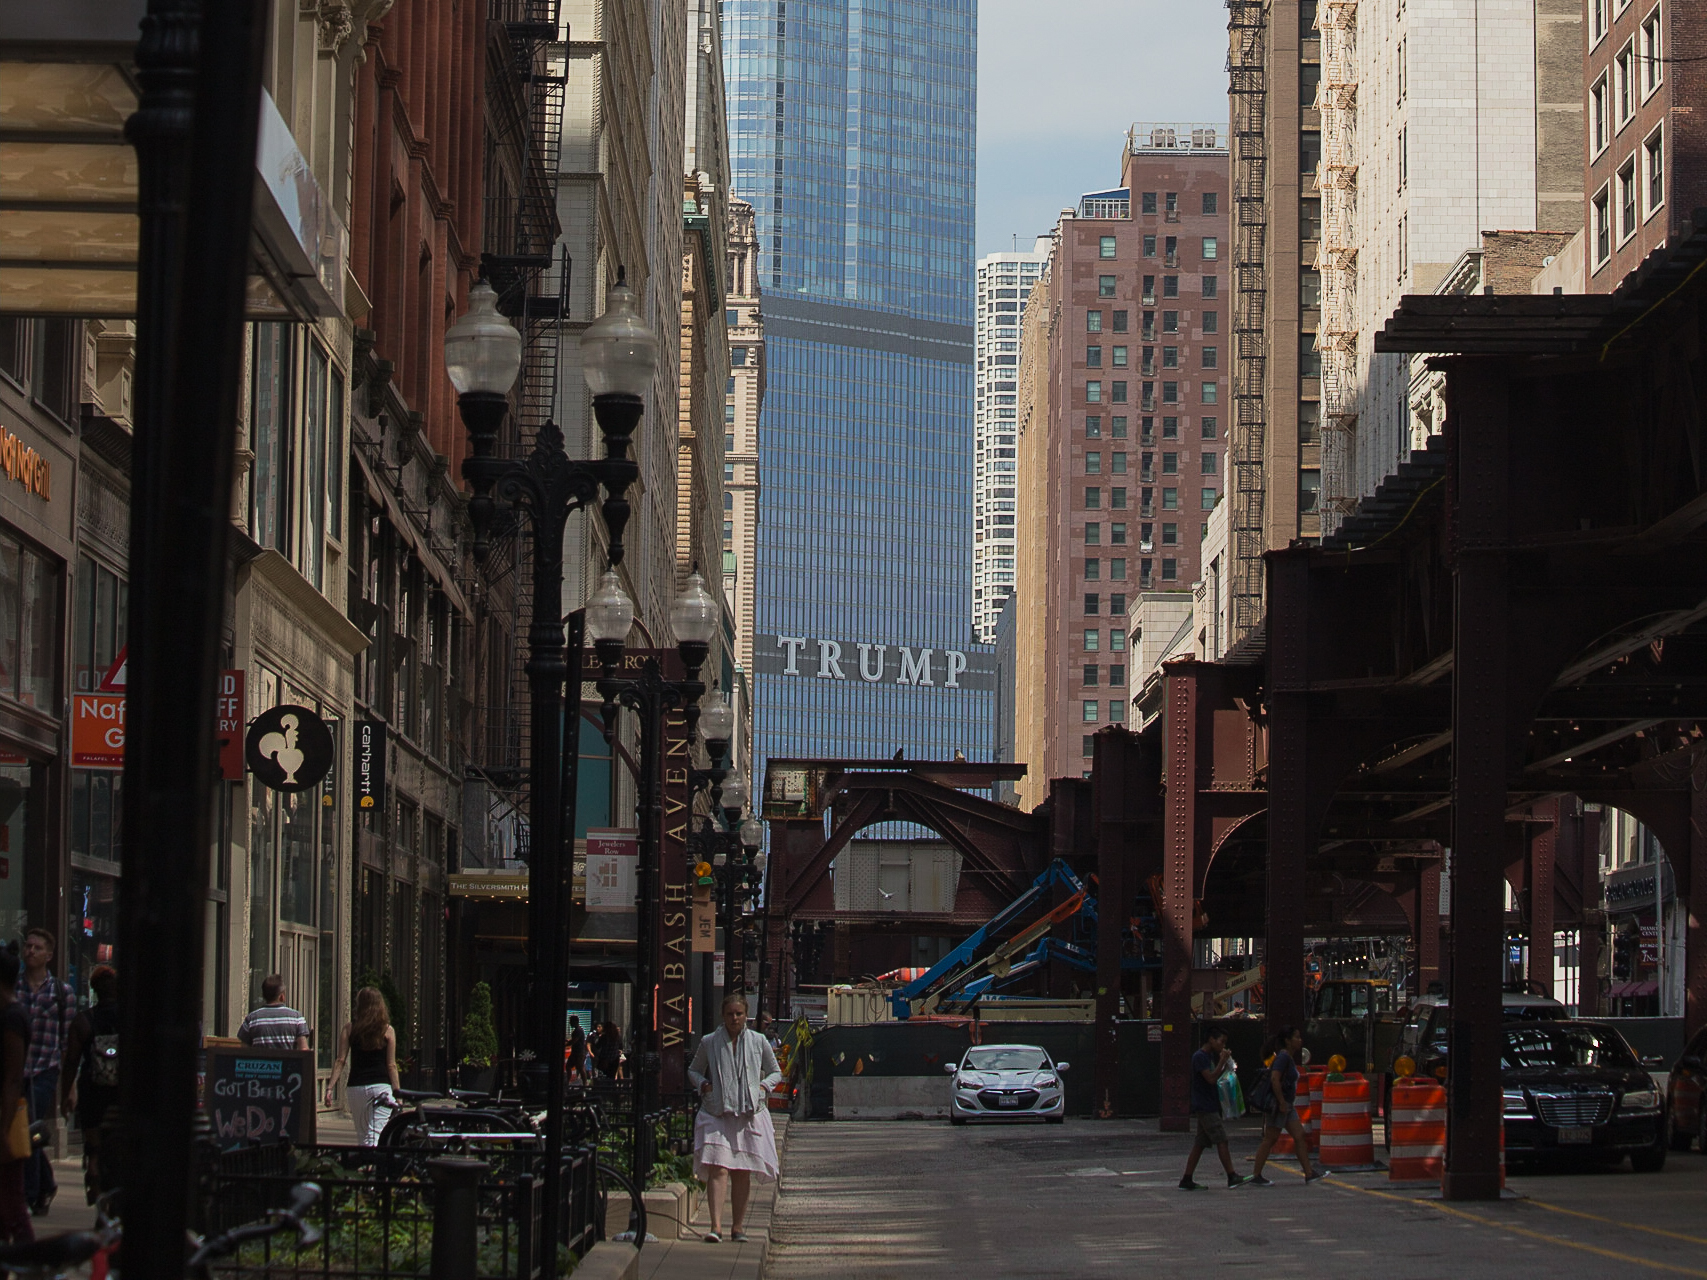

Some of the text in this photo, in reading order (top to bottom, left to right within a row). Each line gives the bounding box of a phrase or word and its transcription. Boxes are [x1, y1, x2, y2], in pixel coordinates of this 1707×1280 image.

[777, 634, 967, 688] TRUMP
[81, 699, 126, 724] Naf
[361, 725, 372, 794] carhartt
[662, 708, 688, 1049] WABASH AVENU
[699, 916, 711, 938] JEM
[237, 1062, 280, 1070] CRUZAN
